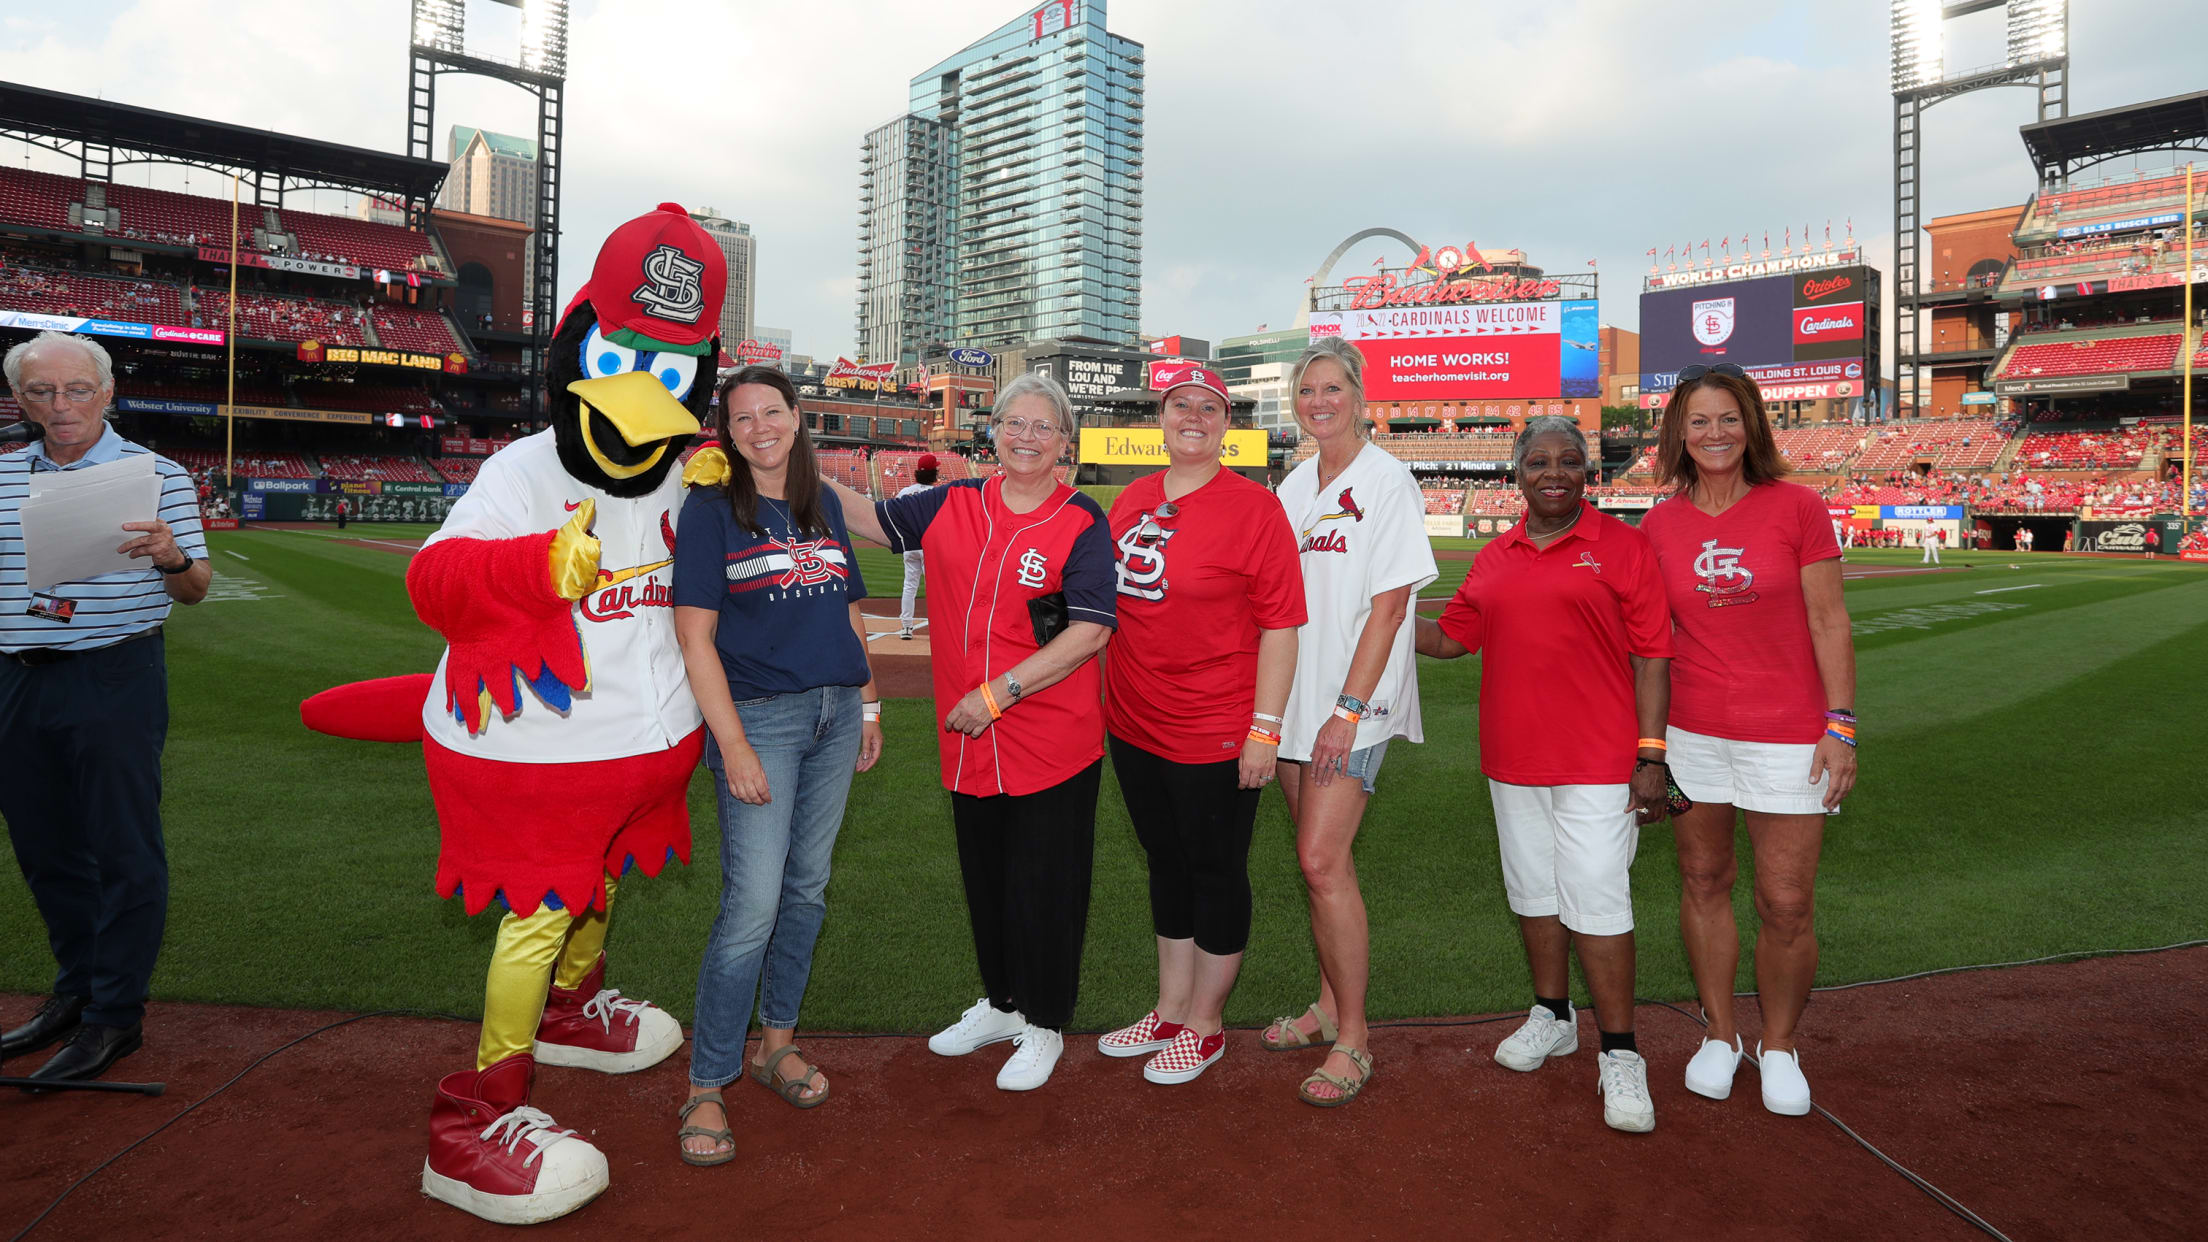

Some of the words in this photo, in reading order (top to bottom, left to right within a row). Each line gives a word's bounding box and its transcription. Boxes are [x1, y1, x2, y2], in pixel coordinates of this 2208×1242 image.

[284, 261, 341, 274] POWER
[1662, 268, 1723, 287] WORLD
[1727, 252, 1840, 279] CHAMPIONS
[1343, 271, 1561, 310] Budweiser
[1803, 275, 1852, 298] Orioles
[1695, 300, 1726, 310] PITCHING
[1392, 309, 1470, 327] CARDINALS
[1476, 306, 1547, 323] WELCOME
[1311, 323, 1341, 333] KMOX
[1800, 316, 1854, 335] Cardinals
[326, 348, 359, 363] BIG
[360, 350, 400, 365] MAC
[400, 353, 442, 370] LAND
[961, 349, 985, 365] Ford
[1390, 354, 1437, 368] HOME
[1442, 352, 1510, 367] WORKS!
[831, 361, 896, 379] Budweiser
[1068, 360, 1101, 373] FROM
[1102, 363, 1123, 375] THE
[1793, 368, 1808, 377] ST.
[1810, 365, 1842, 376] LOUIS
[824, 376, 857, 390] BREW
[1068, 371, 1092, 384] LOU
[1092, 373, 1116, 385] AND
[1392, 371, 1510, 384] teacherhomevisit.org
[1068, 382, 1104, 396] WE'RE
[2004, 385, 2025, 393] Mercy
[127, 400, 164, 412] Webster
[165, 403, 212, 415] University
[1407, 406, 1418, 417] 14
[1424, 406, 1436, 417] 17
[1485, 406, 1500, 416] 24
[1506, 405, 1521, 416] 42
[1528, 405, 1543, 416] 45
[1105, 436, 1169, 457] Edwar
[1413, 461, 1438, 470] Pitch:
[1460, 461, 1496, 470] Minutes
[265, 480, 309, 491] Ballpark
[340, 482, 367, 490] planet
[394, 485, 421, 493] Central
[2097, 530, 2144, 546] Club
